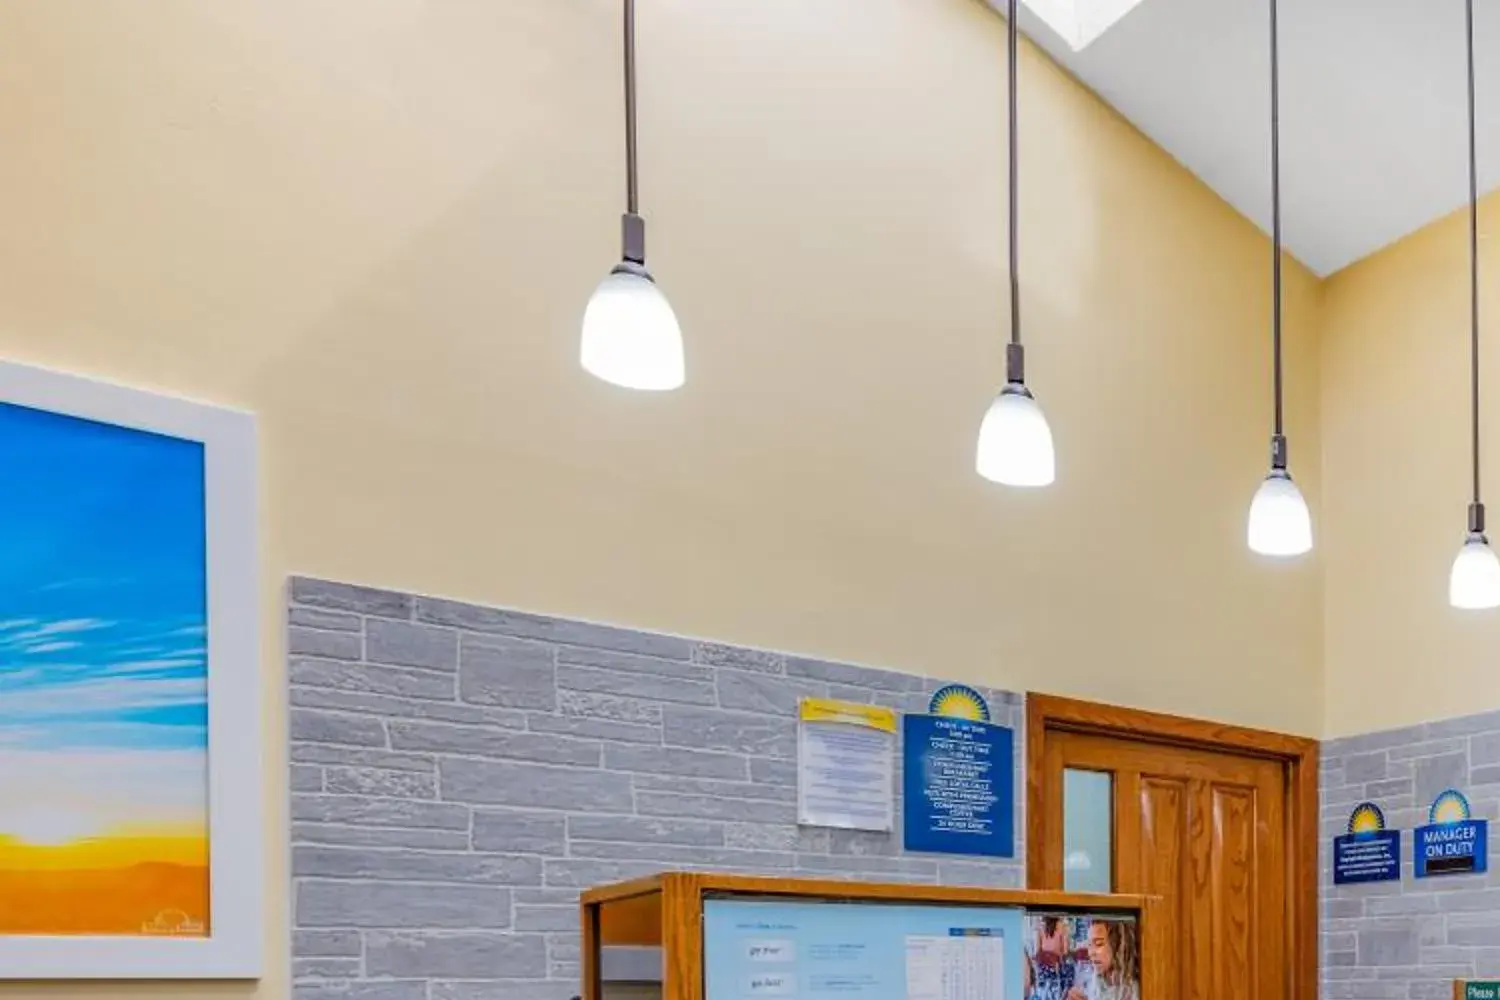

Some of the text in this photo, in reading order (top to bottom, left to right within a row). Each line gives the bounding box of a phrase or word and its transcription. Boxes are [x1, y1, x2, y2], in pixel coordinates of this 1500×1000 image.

[1423, 825, 1477, 843] MANAGER
[1425, 840, 1475, 857] ON DUTY
[1467, 985, 1494, 999] Please
